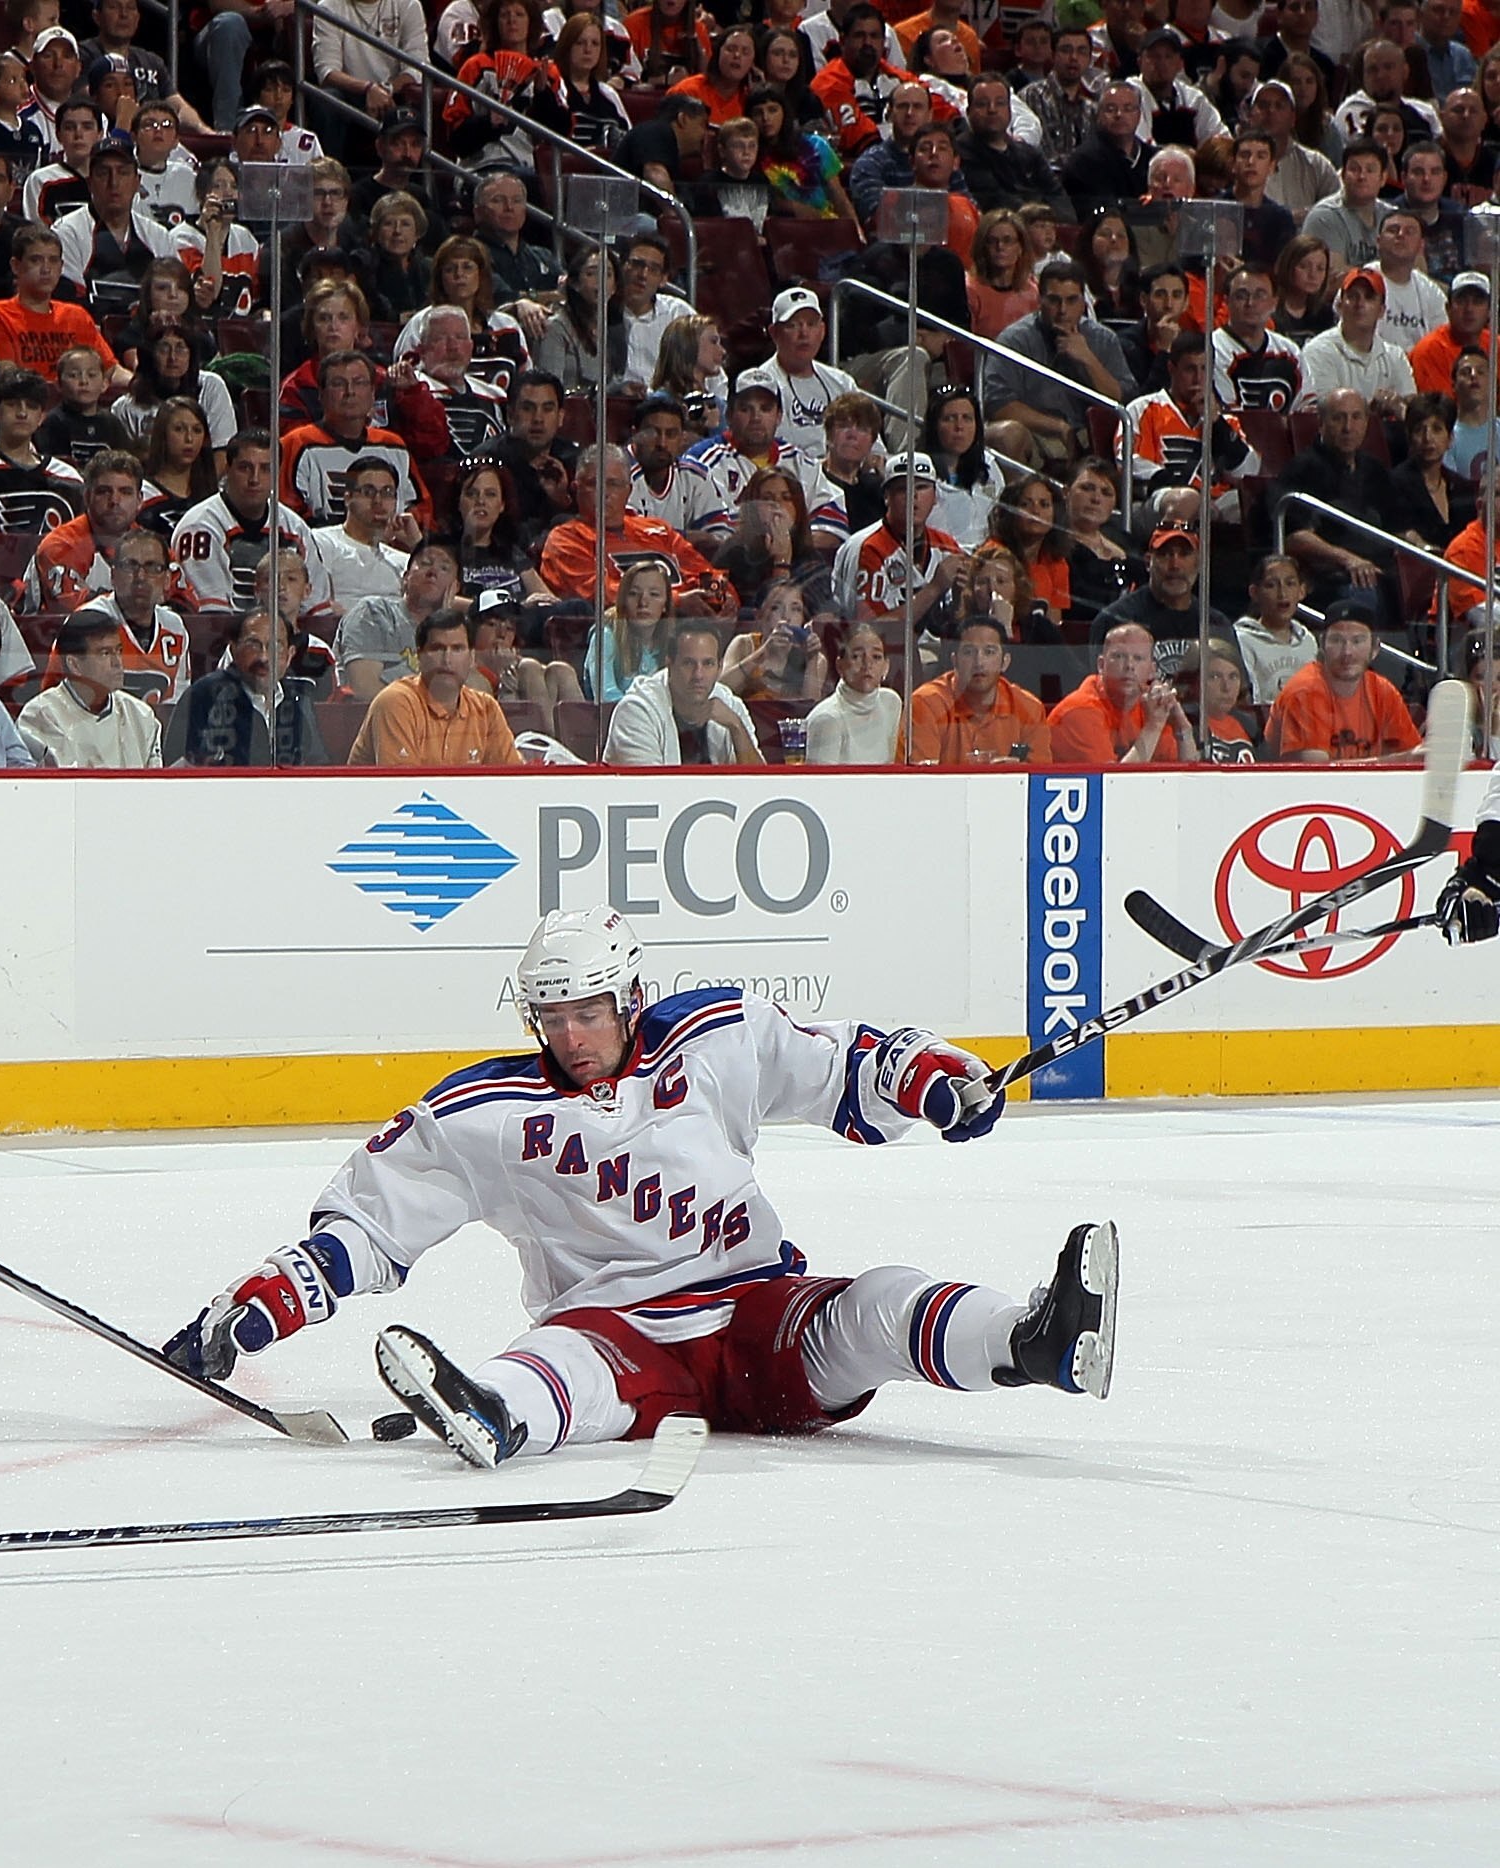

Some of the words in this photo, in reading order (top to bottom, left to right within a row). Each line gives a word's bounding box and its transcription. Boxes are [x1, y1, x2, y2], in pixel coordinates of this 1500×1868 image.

[297, 132, 315, 152] C
[177, 530, 212, 561] 88
[161, 636, 177, 667] C
[538, 798, 831, 917] PECO
[1043, 776, 1088, 1036] Reebok
[535, 977, 570, 987] BAUER
[1049, 962, 1214, 1059] EASTON
[653, 1052, 689, 1110] C
[521, 1112, 752, 1254] RANGERS
